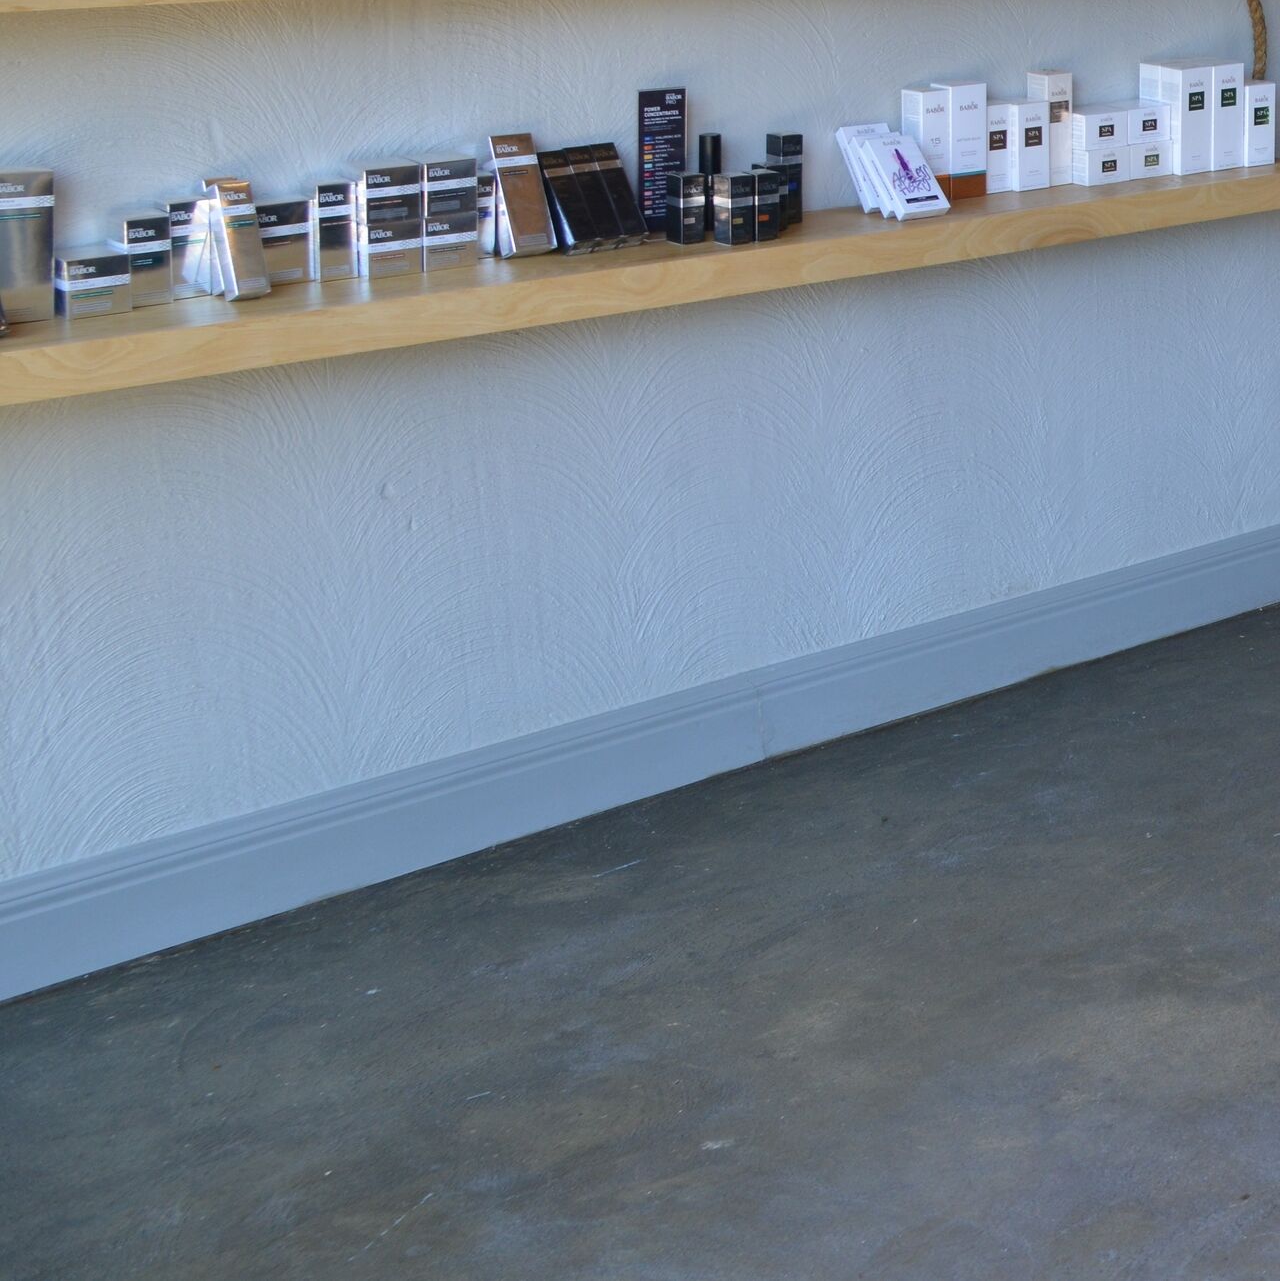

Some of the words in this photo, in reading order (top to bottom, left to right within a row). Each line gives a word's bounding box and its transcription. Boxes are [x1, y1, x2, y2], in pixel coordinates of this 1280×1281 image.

[496, 146, 519, 154] BABOR
[429, 169, 450, 178] BABOR
[368, 176, 391, 185] BABOR
[319, 194, 345, 203] BABOR
[428, 224, 450, 232] BABOR
[128, 229, 156, 239] BABOR
[370, 231, 393, 240] BABOR
[69, 266, 97, 275] BABOR
